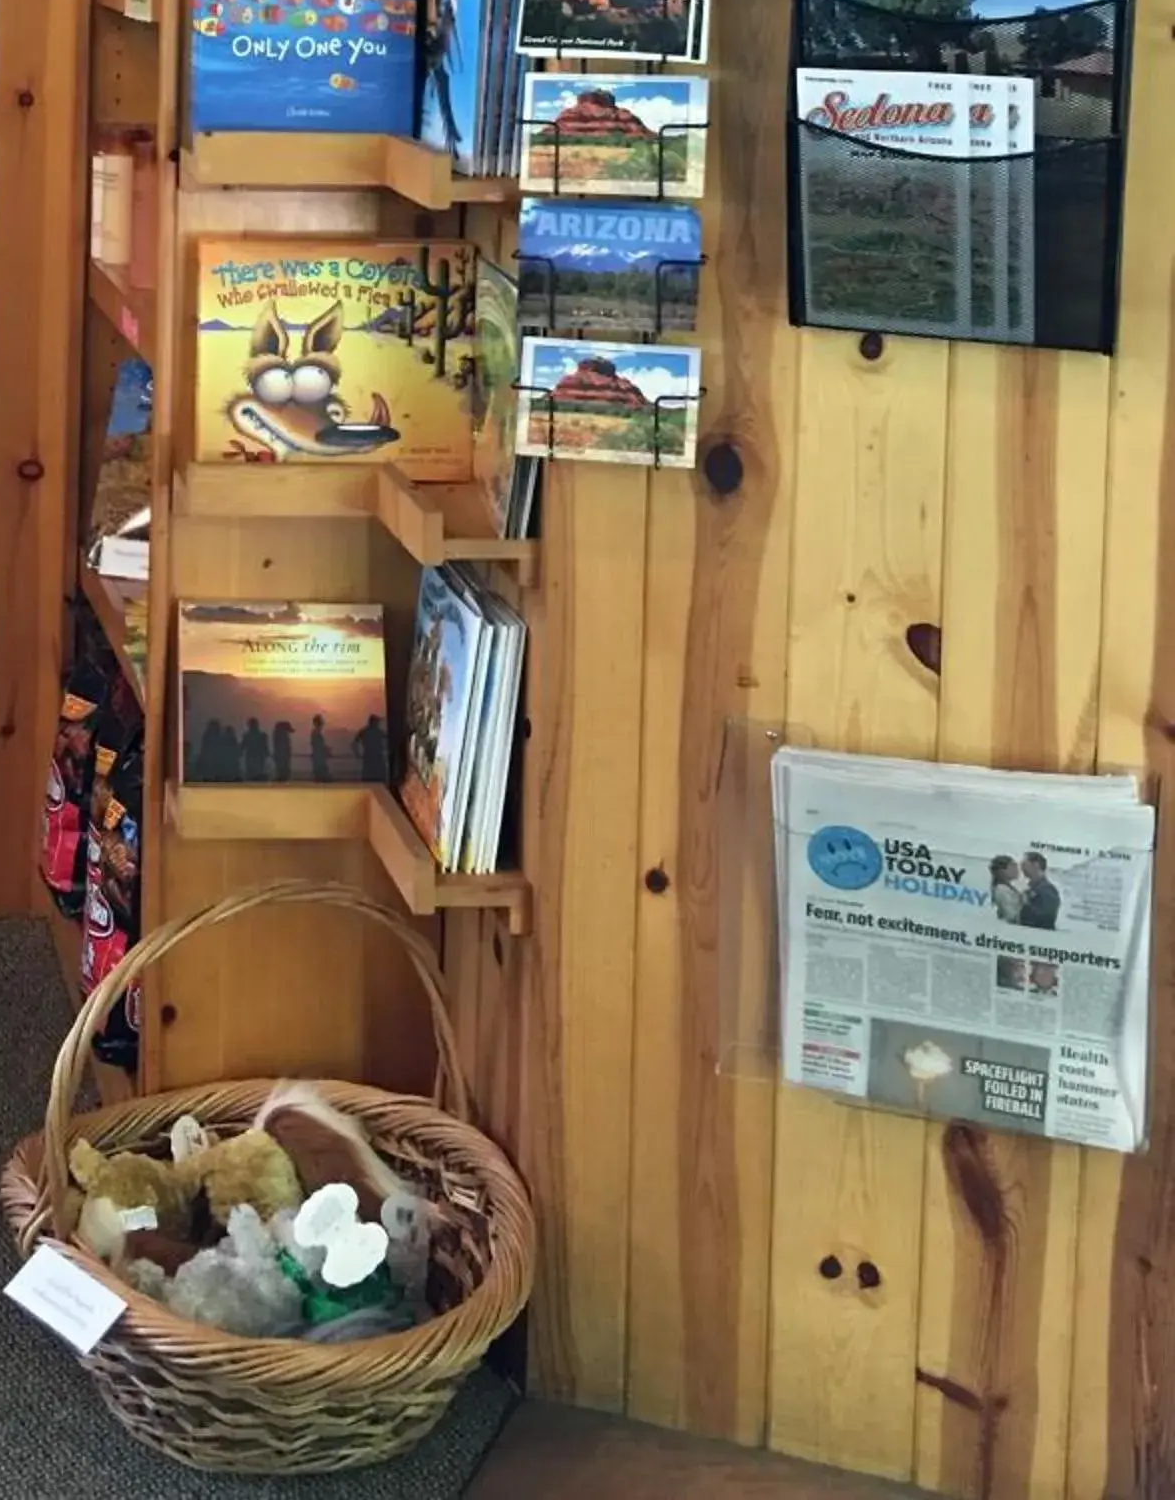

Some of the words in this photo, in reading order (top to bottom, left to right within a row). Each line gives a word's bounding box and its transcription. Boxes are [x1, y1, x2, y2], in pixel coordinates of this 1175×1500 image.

[806, 90, 956, 134] Sedona
[534, 211, 693, 244] ARIZONA
[240, 638, 299, 654] ALONG
[303, 636, 328, 654] the
[883, 837, 932, 862] USA
[884, 855, 967, 885] TODAY
[883, 873, 990, 907] HOLIDAY
[805, 902, 843, 924] Fear,
[846, 910, 874, 927] not
[877, 915, 972, 946] excitement,
[975, 932, 1026, 955] drives
[1028, 943, 1122, 970] supporters
[1060, 1045, 1110, 1066] Health
[964, 1058, 1045, 1087] SPACEFLIGHT
[983, 1079, 1025, 1099] FOILED
[1030, 1087, 1044, 1102] IN
[984, 1095, 1043, 1119] FIREBALL
